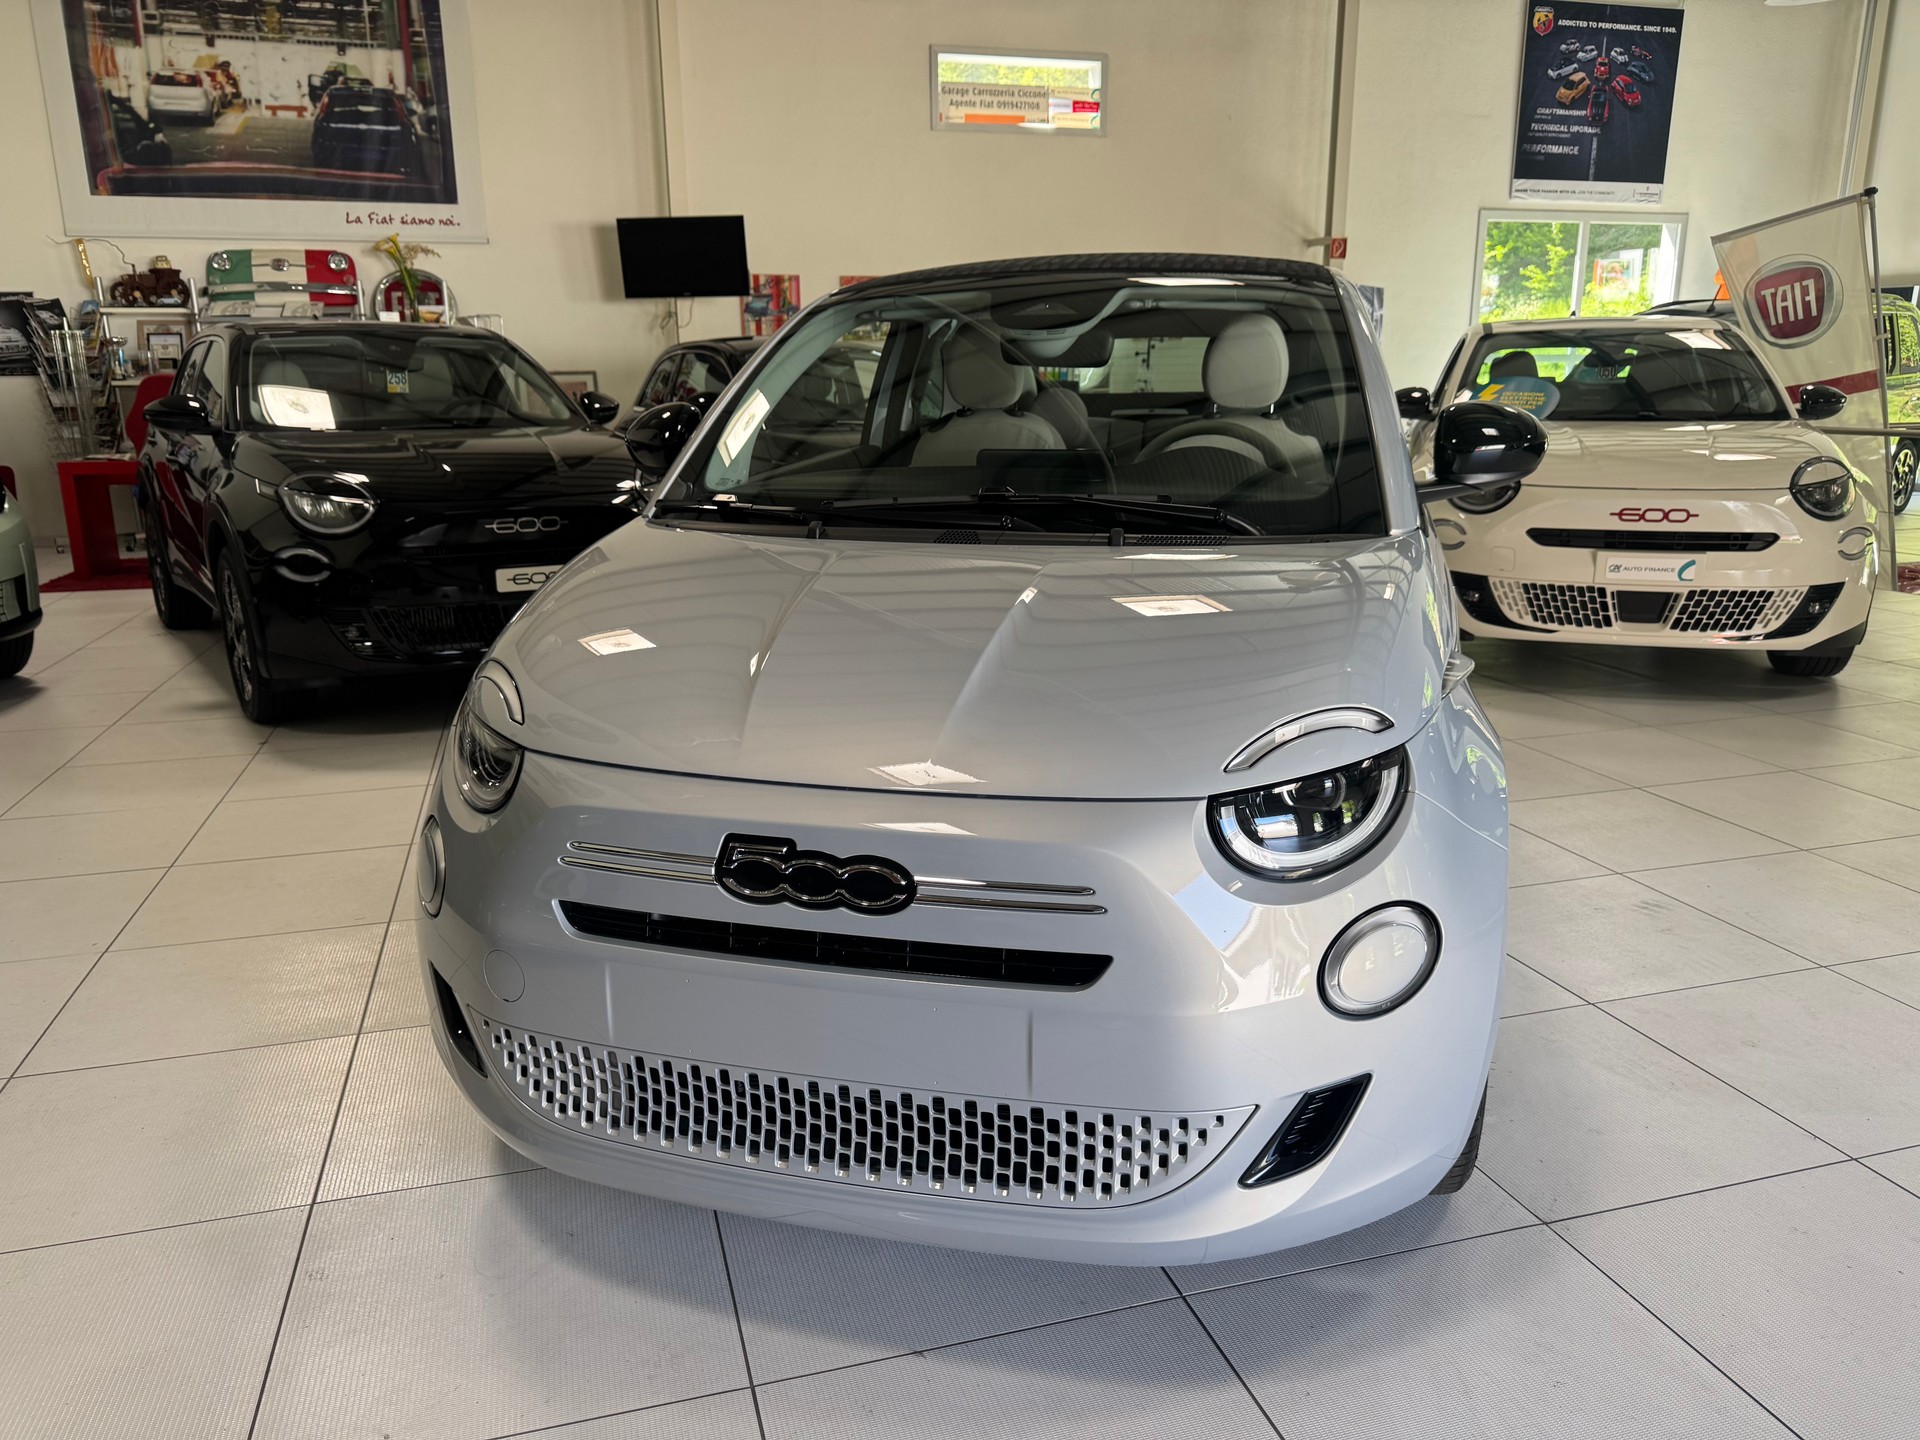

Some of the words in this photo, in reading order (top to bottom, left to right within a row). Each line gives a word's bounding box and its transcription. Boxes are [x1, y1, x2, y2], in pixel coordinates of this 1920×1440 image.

[1557, 19, 1588, 28] ADDICTED
[1597, 23, 1643, 32] PERFORMANCE.
[1643, 25, 1662, 33] SINCE
[1662, 26, 1677, 34] 1949.
[941, 86, 970, 97] Garage
[972, 87, 1016, 97] Carrozzeria
[1017, 89, 1047, 99] Ciccone
[949, 98, 978, 109] Agente
[979, 99, 995, 109] Fiat
[1536, 107, 1587, 117] CRAFTSMANSHIP
[1530, 122, 1569, 133] TECHNICAL
[1521, 143, 1580, 155] PERFORMANCE
[345, 211, 363, 225] La
[367, 211, 396, 226] Fiat
[400, 213, 435, 226] siamo
[438, 214, 461, 227] noi.
[388, 371, 407, 385] 258
[1616, 508, 1692, 523] 600
[492, 516, 562, 534] 600
[718, 838, 912, 912] 500
